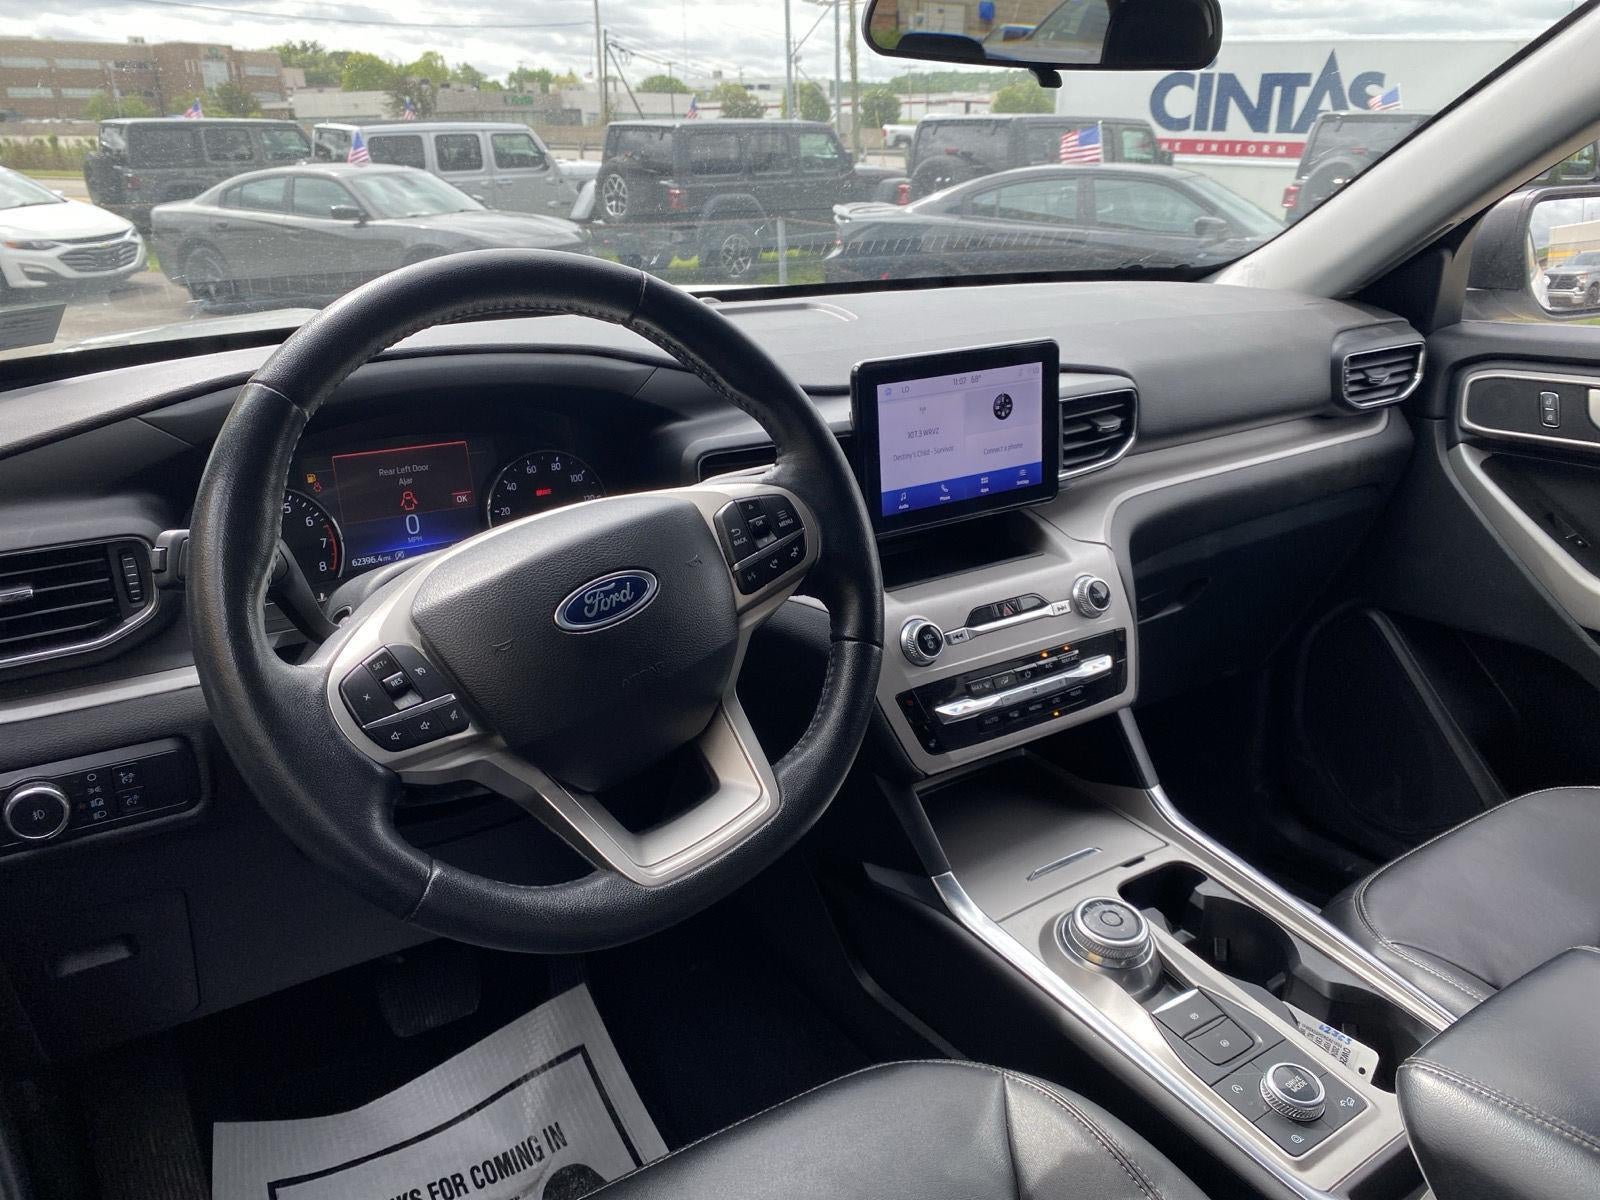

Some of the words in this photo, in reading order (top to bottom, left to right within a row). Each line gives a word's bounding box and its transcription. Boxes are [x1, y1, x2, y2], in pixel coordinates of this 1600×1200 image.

[1195, 142, 1287, 155] UNIFORM
[378, 467, 395, 477] Rear
[396, 465, 411, 474] Left
[412, 463, 429, 472] Door
[526, 465, 537, 474] 60
[550, 462, 561, 471] 80
[570, 473, 583, 482] 100
[506, 482, 517, 491] 40
[456, 494, 468, 503] OK
[283, 502, 292, 514] 5
[501, 506, 511, 516] 20
[305, 516, 314, 527] 6
[405, 513, 420, 535] 0
[319, 537, 327, 549] 7
[351, 554, 383, 567] 62396.4
[318, 561, 327, 572] 8
[583, 581, 635, 618] Ford
[390, 677, 404, 688] RES
[427, 1172, 470, 1200] FOR
[469, 1135, 545, 1190] COMING
[542, 1121, 568, 1153] IN
